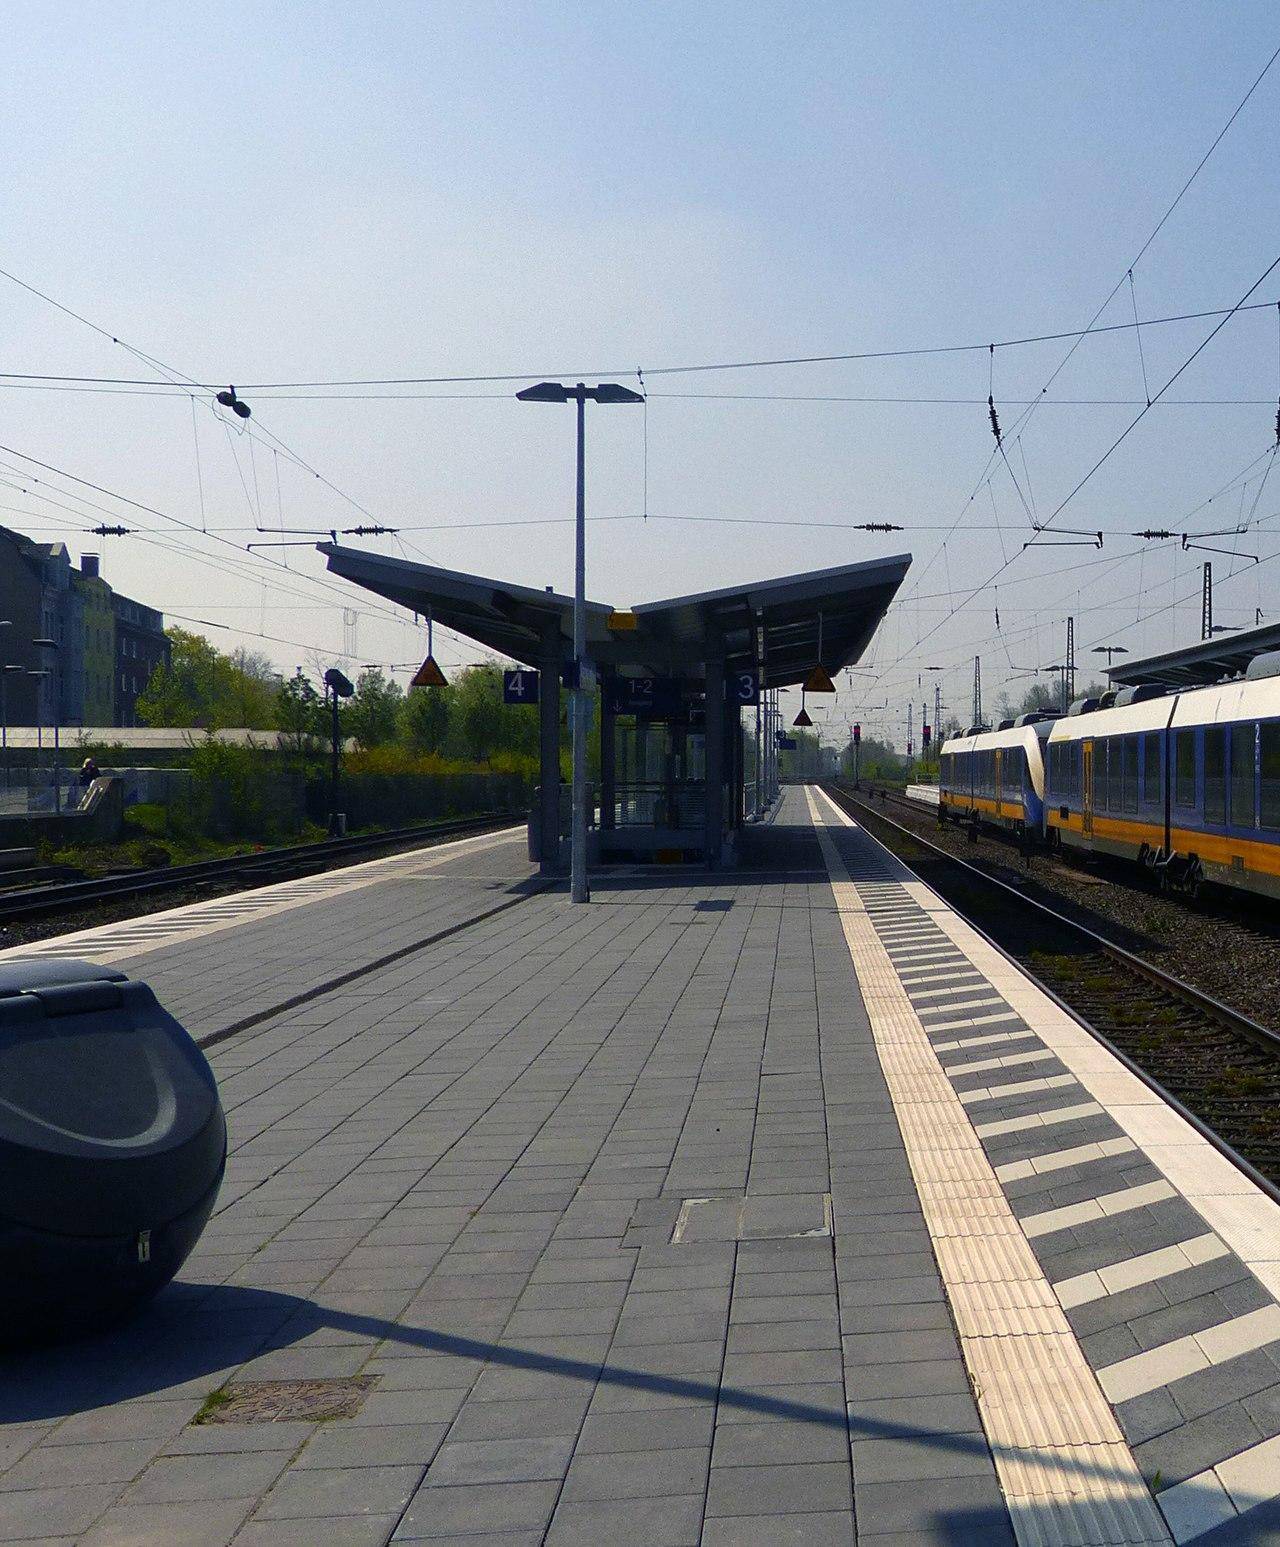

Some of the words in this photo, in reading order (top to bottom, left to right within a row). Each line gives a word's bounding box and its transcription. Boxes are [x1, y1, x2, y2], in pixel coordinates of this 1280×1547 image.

[508, 673, 525, 696] 4
[628, 679, 653, 694] 1-2
[737, 675, 754, 699] 3
